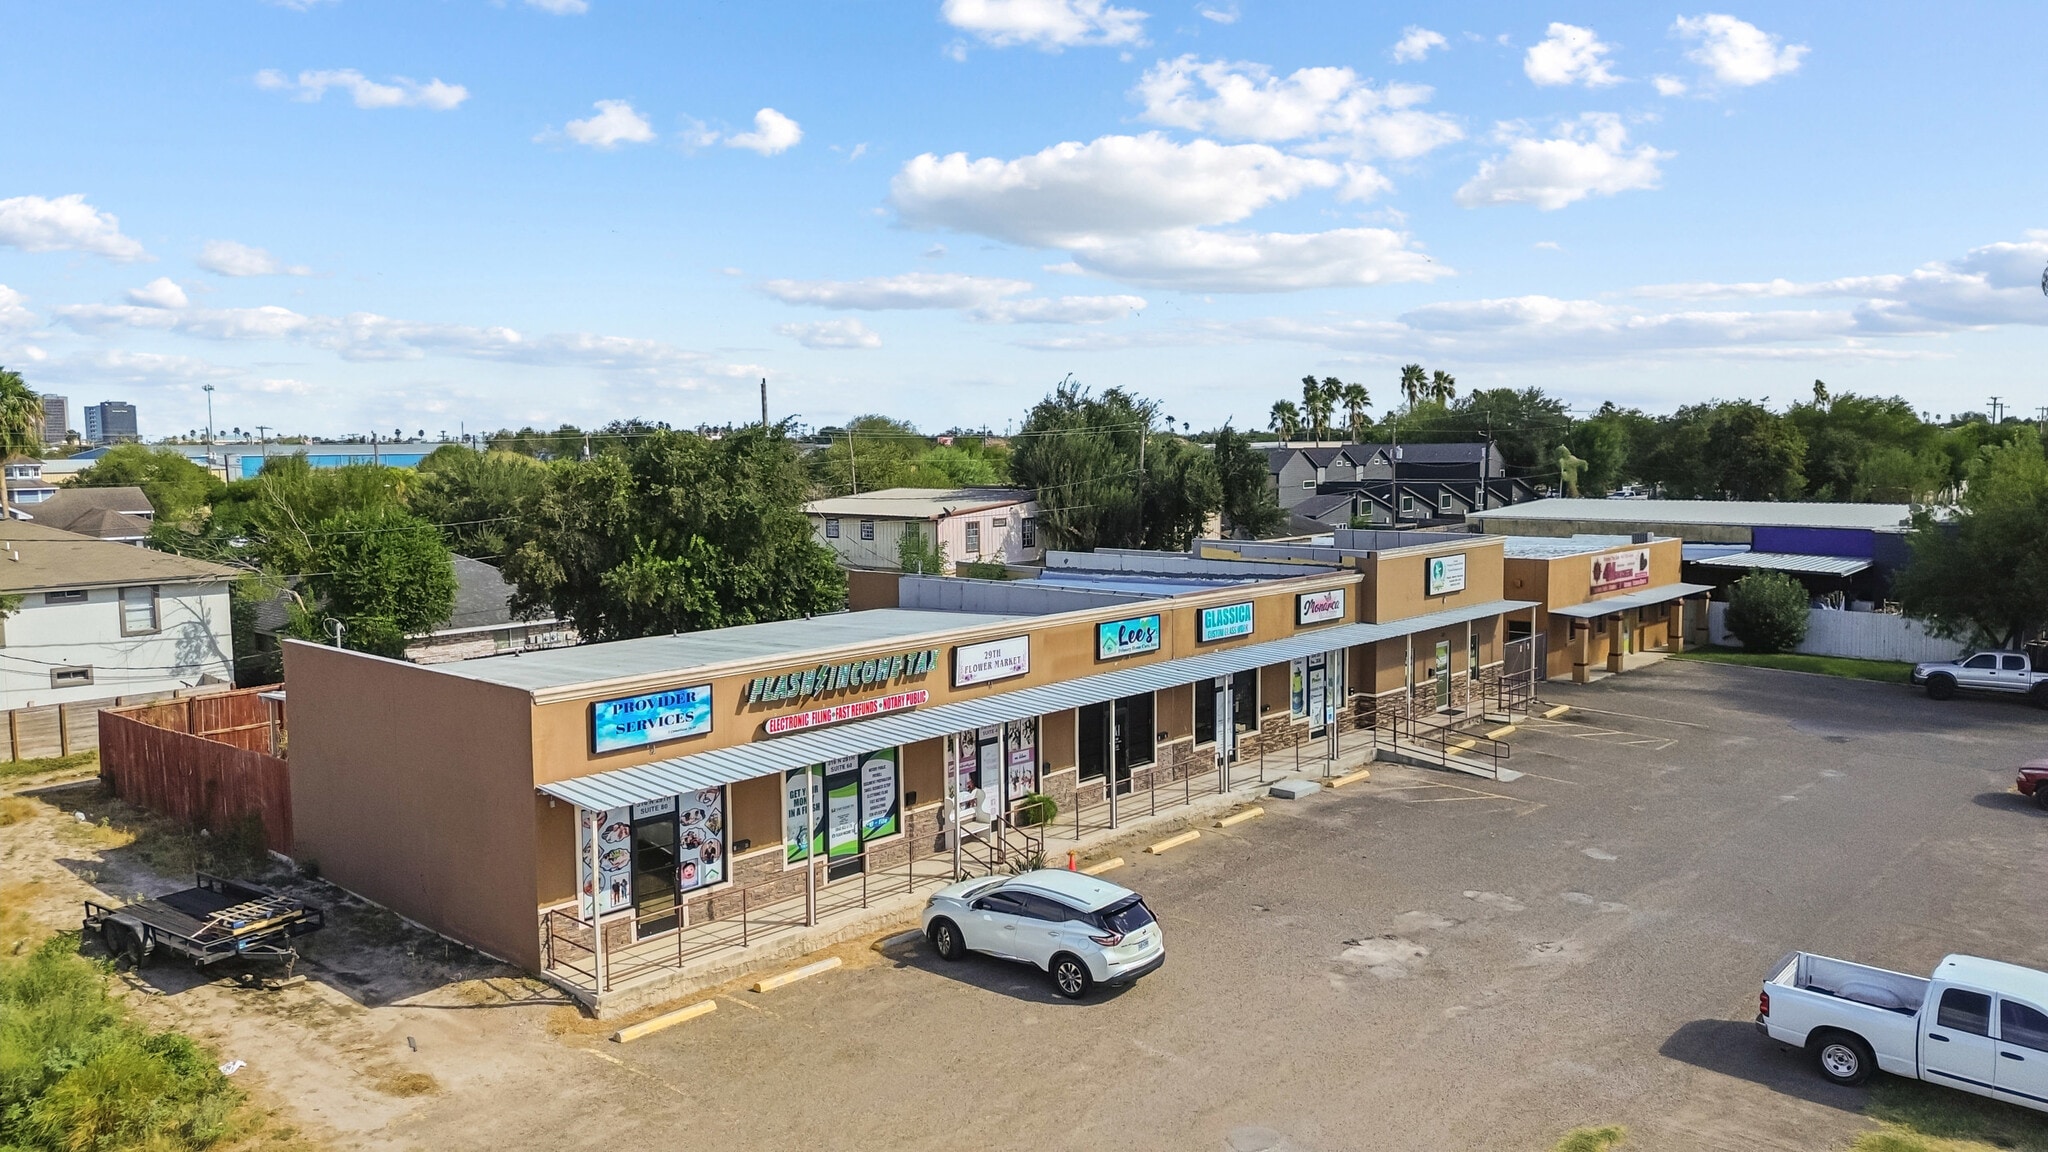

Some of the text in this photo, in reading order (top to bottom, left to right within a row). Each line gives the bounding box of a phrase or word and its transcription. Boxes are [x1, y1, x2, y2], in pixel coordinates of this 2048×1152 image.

[1205, 605, 1251, 628] GLASSICA
[984, 649, 1001, 660] 29TH
[964, 656, 1021, 674] FLOWER MARKET
[749, 648, 941, 703] FLASH INCOME TAX
[613, 692, 697, 715] PROVIDER
[769, 690, 927, 733] ELECTRONIC FILING FAST REFUNDS NOTARY PUBLIC
[615, 711, 694, 735] SERVICES
[790, 785, 819, 799] GET YR
[640, 806, 659, 815] SUITE
[789, 802, 820, 818] IN A FLSH
